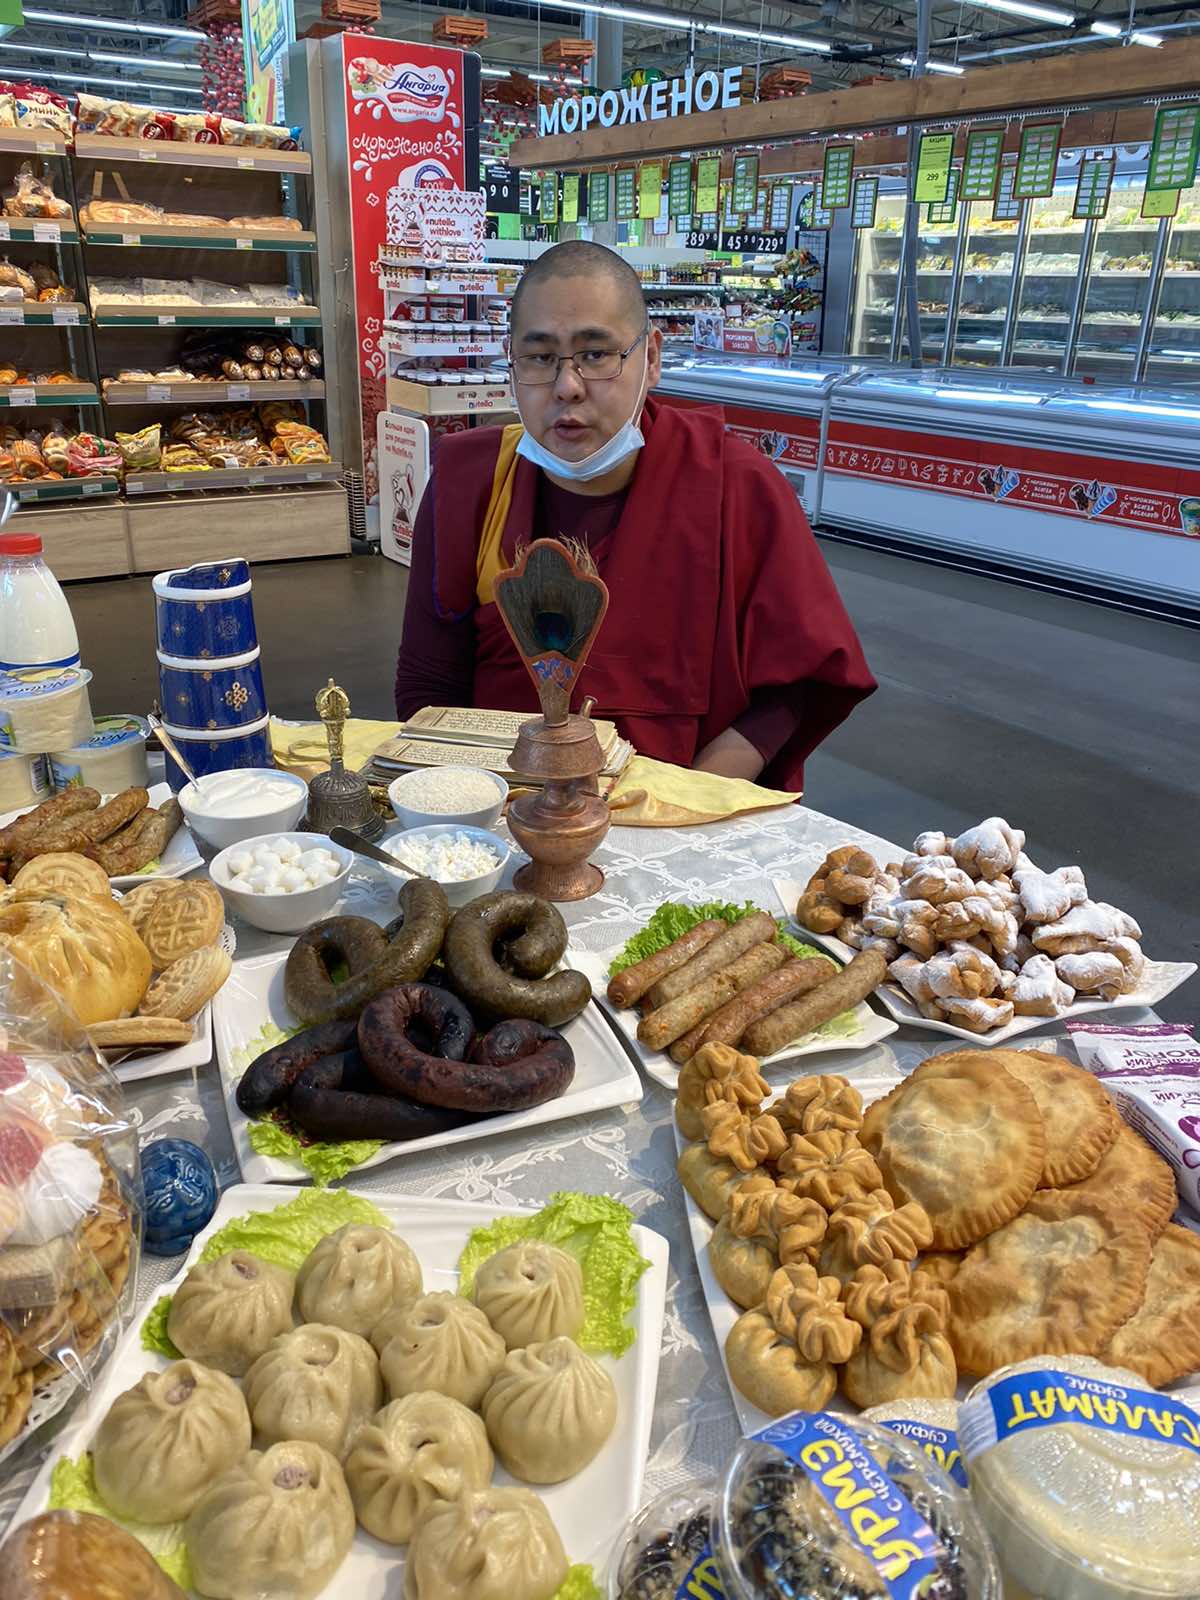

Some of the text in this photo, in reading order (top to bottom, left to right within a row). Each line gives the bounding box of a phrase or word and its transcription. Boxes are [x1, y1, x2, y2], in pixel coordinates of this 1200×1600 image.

[539, 66, 742, 137] МОРОЖЕНОЕ
[425, 217, 456, 227] #nutella
[430, 228, 462, 237] withlove
[459, 283, 484, 292] nutella
[458, 344, 483, 353] nutella
[469, 400, 493, 409] nutella
[1065, 1375, 1127, 1399] СУФЛЕ
[1007, 1386, 1200, 1447] САЛАМАТ
[813, 1418, 889, 1500] ЧЕРЕМУХОЙ
[801, 1439, 923, 1580] УРМЭ
